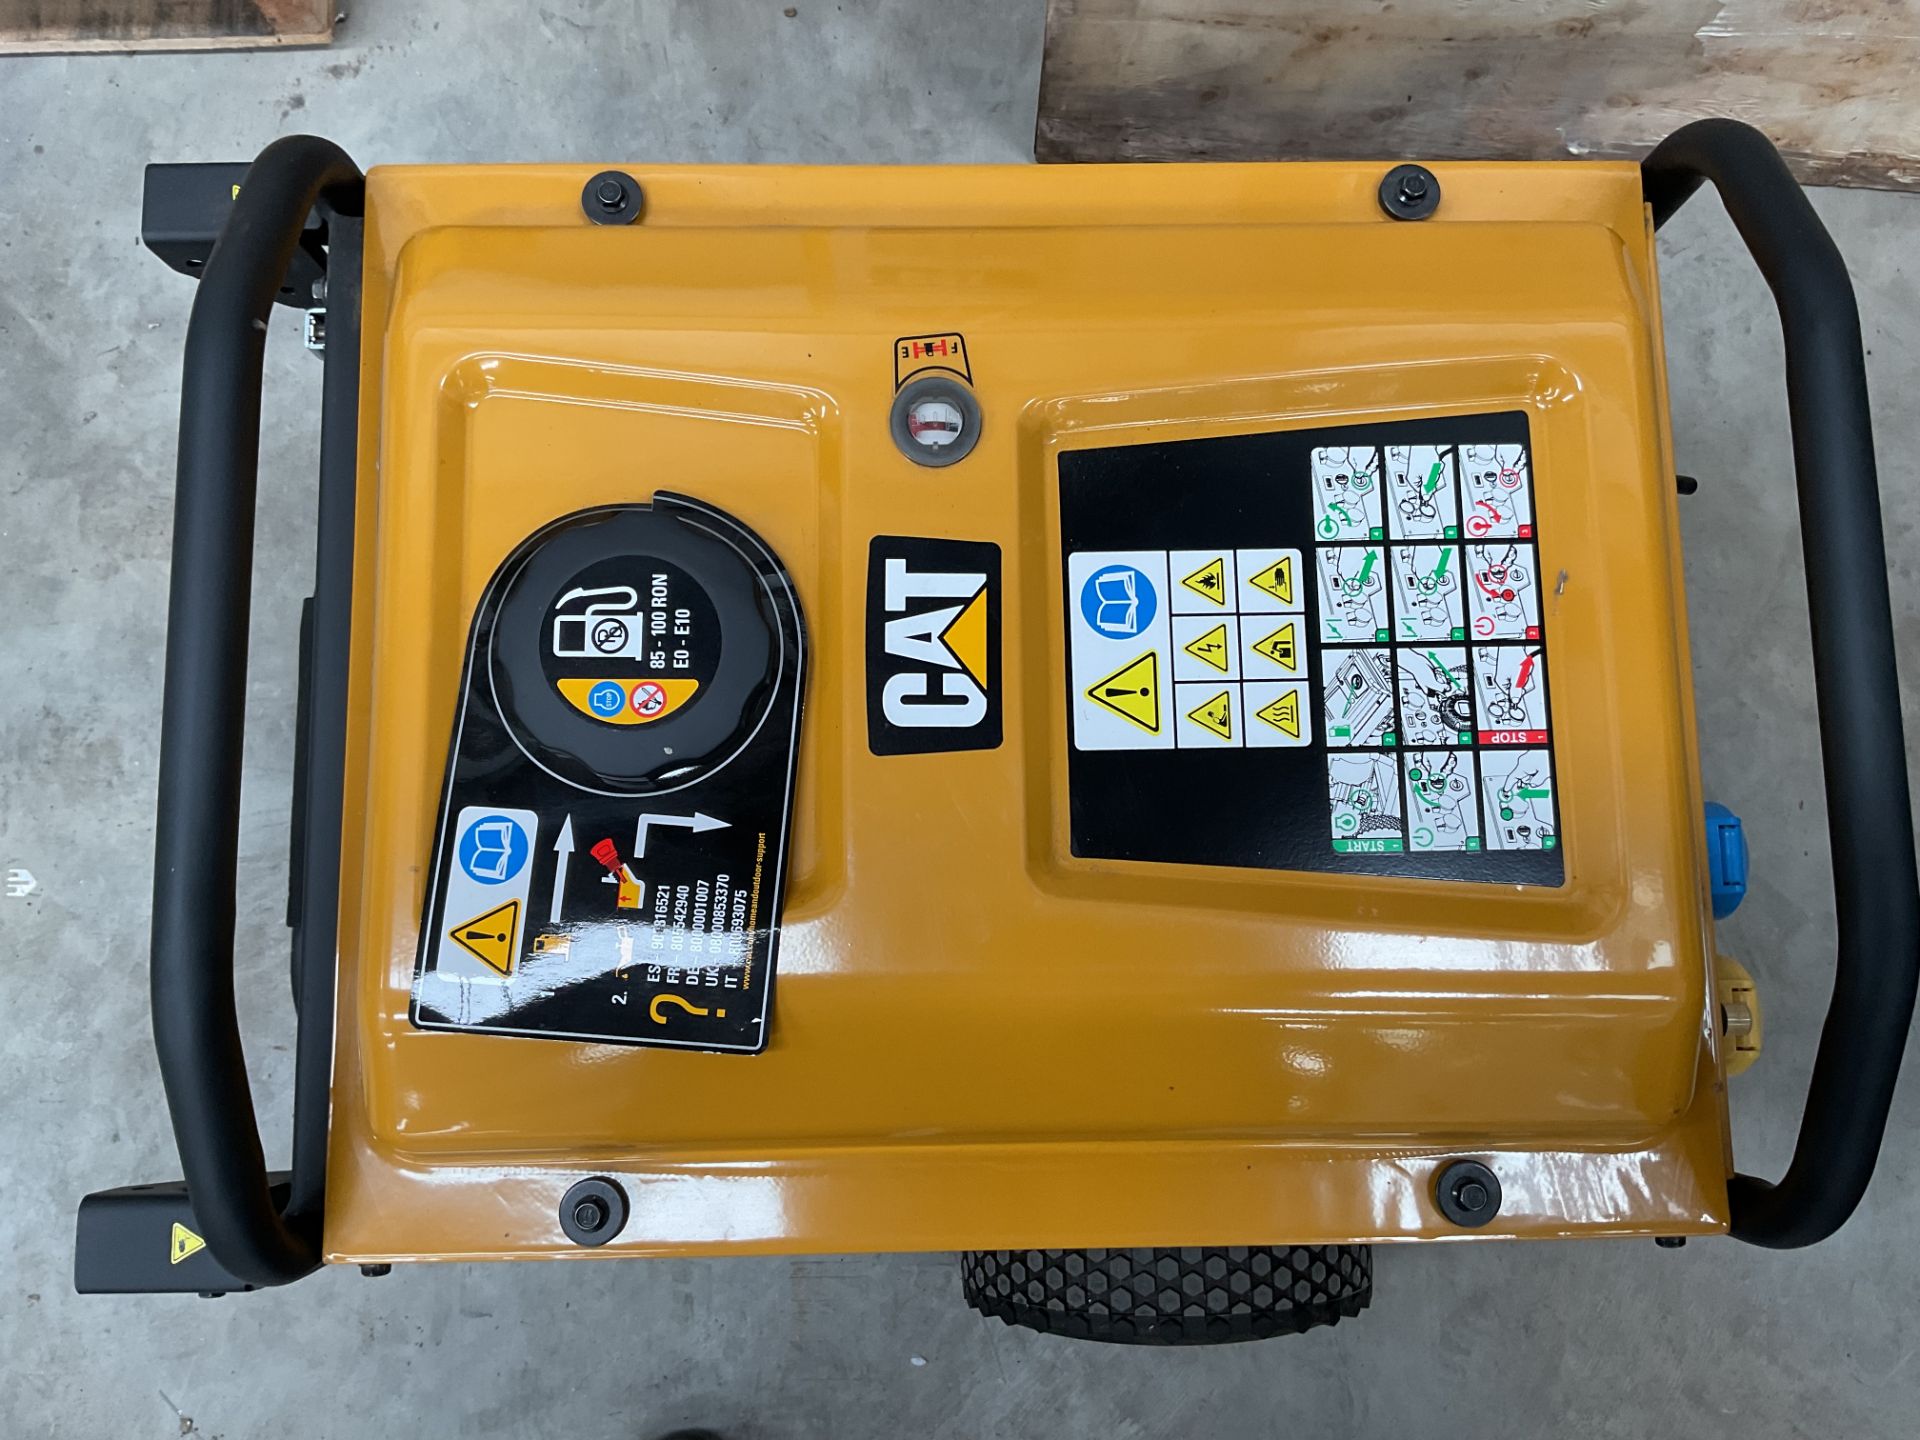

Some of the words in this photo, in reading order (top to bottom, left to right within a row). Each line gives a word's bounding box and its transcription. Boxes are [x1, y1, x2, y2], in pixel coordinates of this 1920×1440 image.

[901, 346, 909, 358] E
[951, 342, 958, 354] F
[651, 574, 668, 608] RON
[651, 611, 667, 637] 100
[674, 609, 691, 635] E10
[882, 558, 988, 728] CAT
[650, 651, 665, 669] 85
[673, 650, 689, 669] E0
[1491, 732, 1527, 743] STOP
[1347, 840, 1385, 852] START
[651, 885, 671, 950] 90816521
[671, 885, 690, 951] 805542940
[690, 879, 710, 952] 8000001007
[709, 874, 730, 954] 08000853370
[728, 890, 748, 954] 800693075
[647, 965, 660, 983] ES
[666, 966, 680, 984] FR
[685, 967, 699, 985] DE
[705, 969, 719, 987] UK
[724, 974, 738, 989] IT
[611, 991, 628, 1005] 2.
